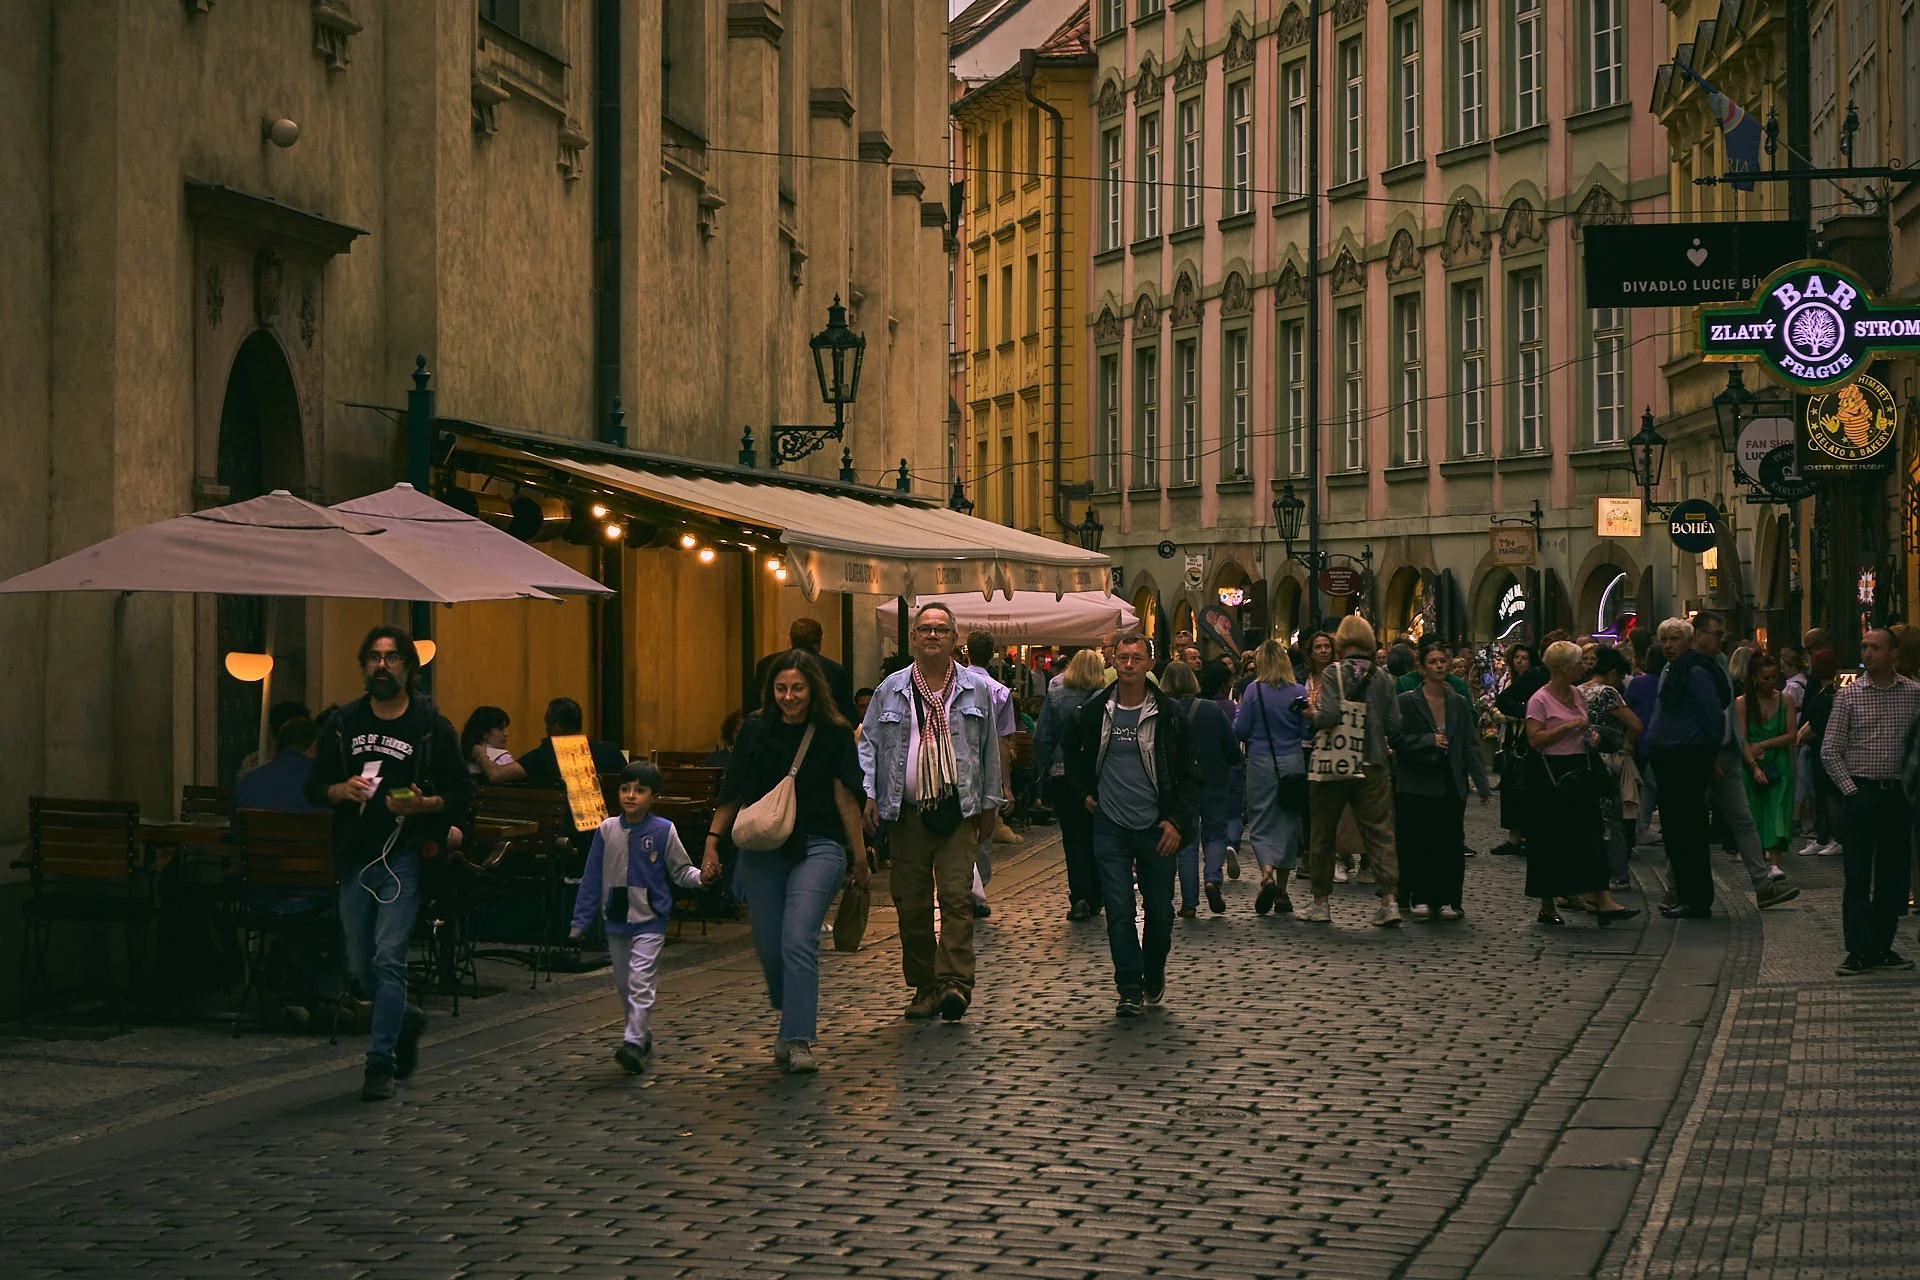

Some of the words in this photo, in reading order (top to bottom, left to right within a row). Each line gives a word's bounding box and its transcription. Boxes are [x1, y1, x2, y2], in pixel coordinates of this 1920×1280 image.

[1623, 280, 1688, 293] DIVADLO
[1692, 278, 1736, 291] LUCIE
[1772, 275, 1857, 312] BAR
[1711, 319, 1777, 341] ZLATÝ
[1854, 319, 1920, 337] STROM
[1779, 352, 1854, 379] PRAGUE
[1858, 376, 1891, 402] HIMNEY
[1745, 440, 1767, 449] FAN
[1815, 432, 1846, 456] GELATO
[1849, 449, 1856, 458] &
[1859, 430, 1890, 456] BAKERY
[1770, 480, 1811, 496] KARLOVA
